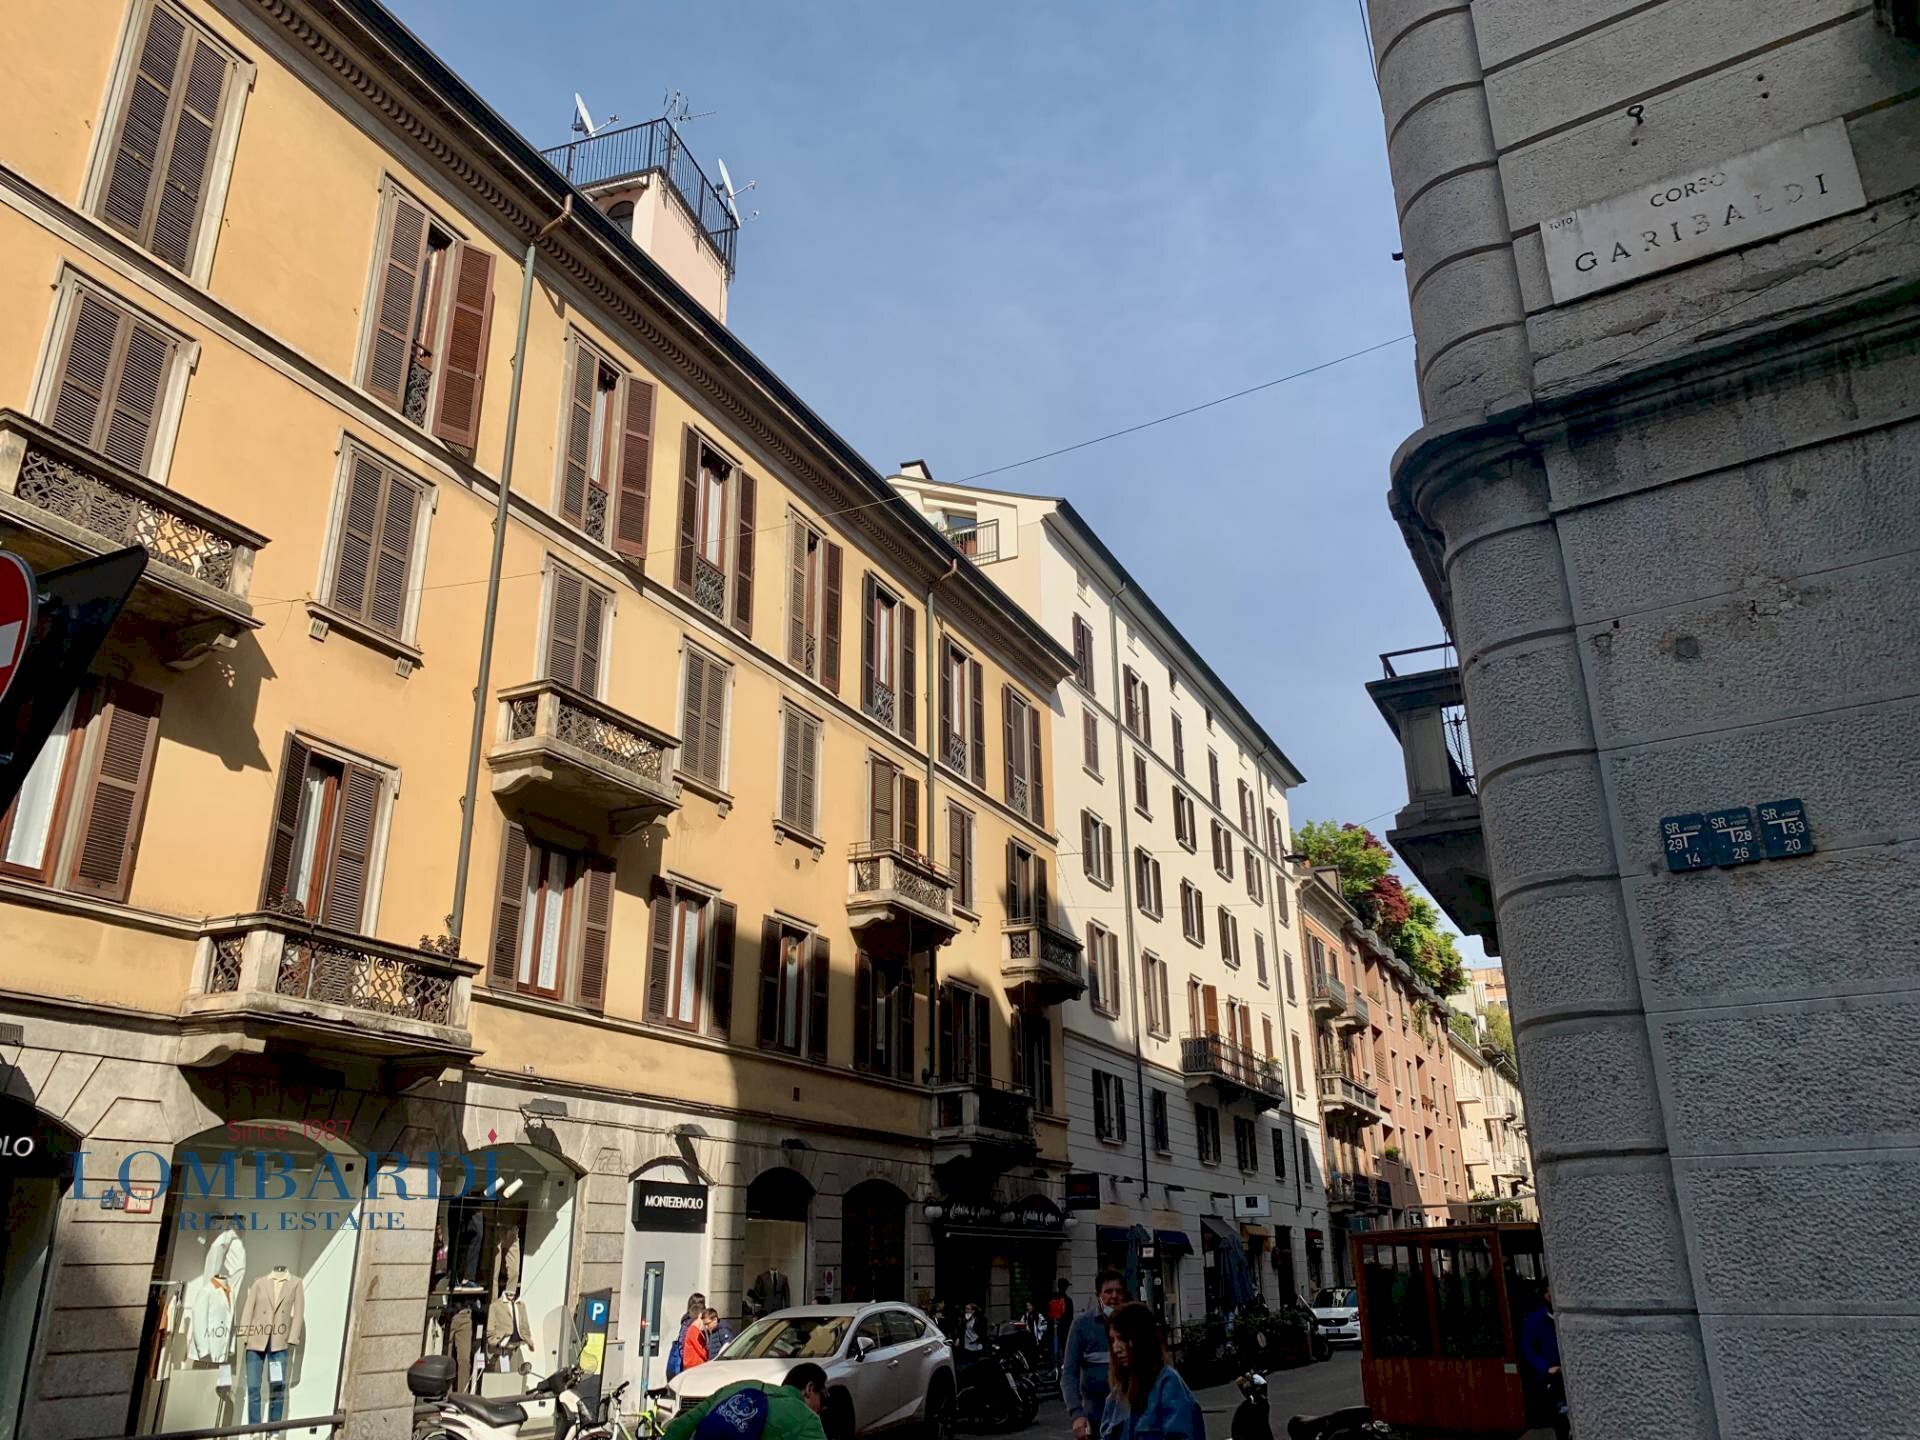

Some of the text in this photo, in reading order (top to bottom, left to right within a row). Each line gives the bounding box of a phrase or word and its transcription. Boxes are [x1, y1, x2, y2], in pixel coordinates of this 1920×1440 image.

[1650, 171, 1727, 208] CORSO
[1575, 173, 1828, 273] GARIBALDI
[1710, 816, 1727, 829] SR
[1761, 808, 1778, 821] SR
[1664, 822, 1681, 835] SR
[0, 1135, 34, 1157] LO
[644, 1194, 704, 1211] MONTEZEMOLO
[592, 1302, 605, 1321] P
[204, 1323, 287, 1338] MONTEZEMOLO
